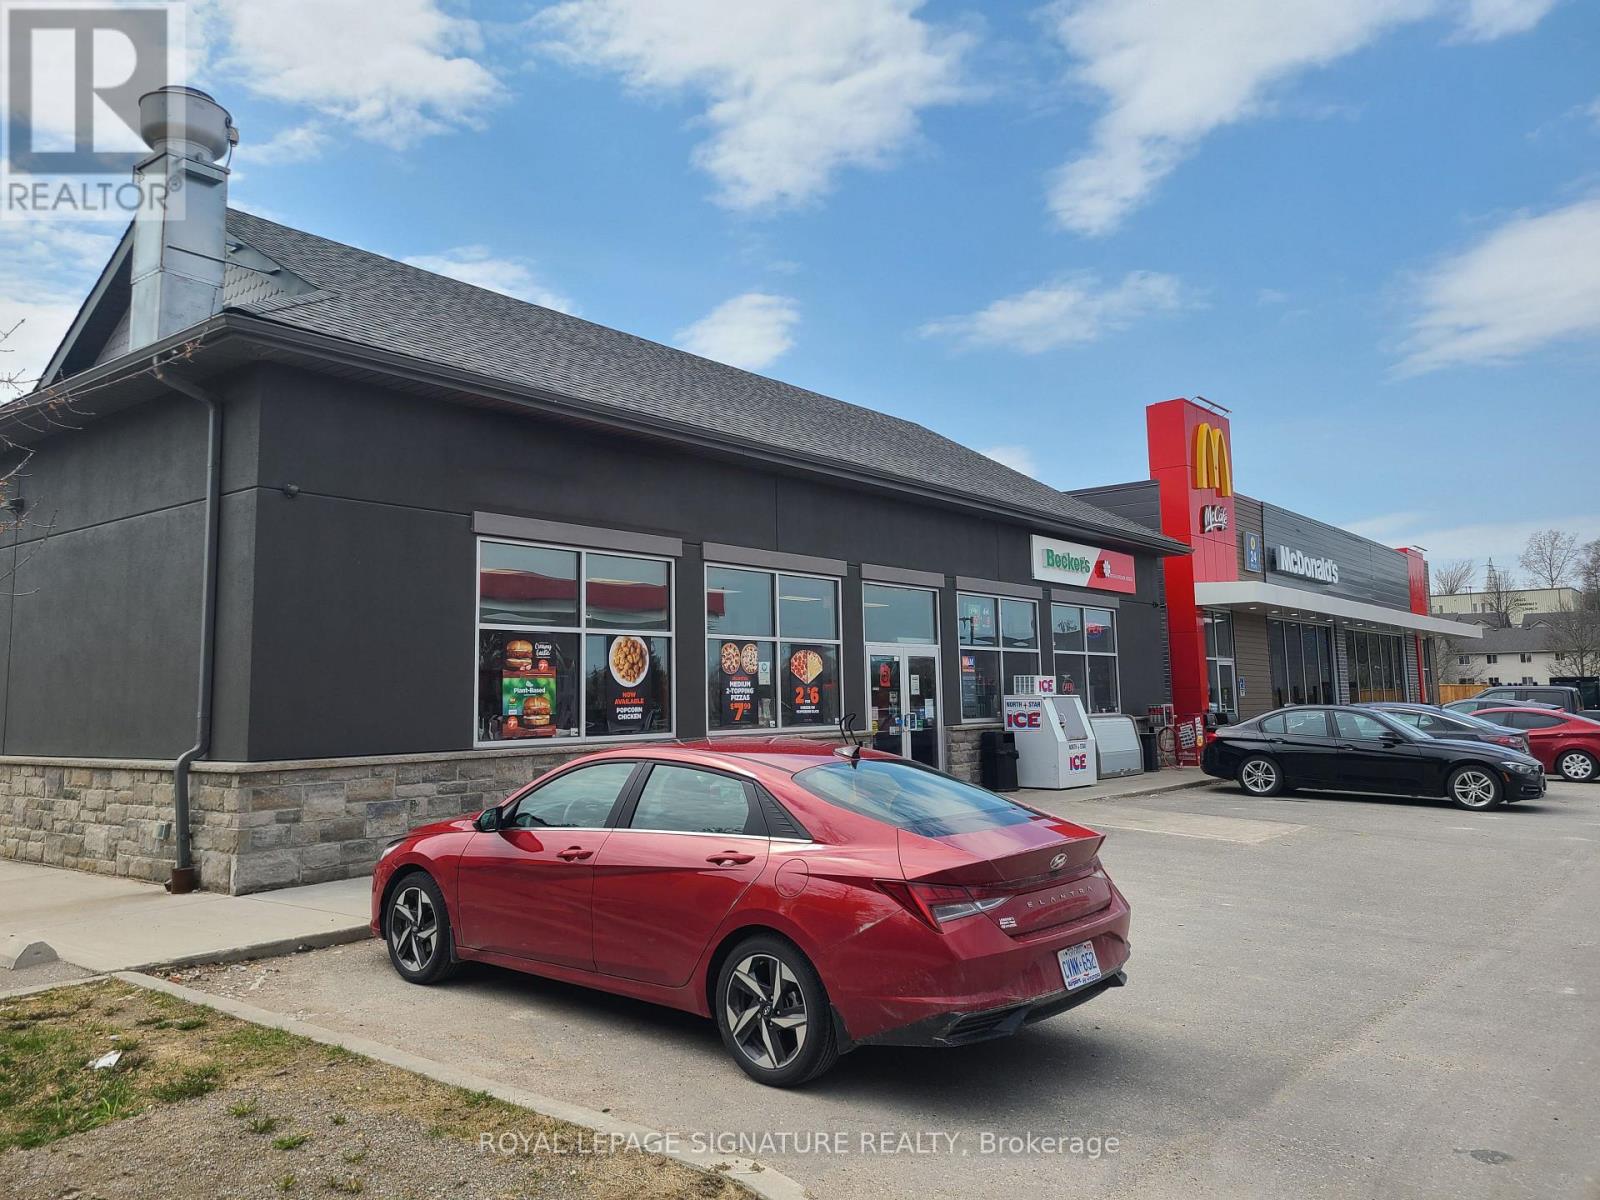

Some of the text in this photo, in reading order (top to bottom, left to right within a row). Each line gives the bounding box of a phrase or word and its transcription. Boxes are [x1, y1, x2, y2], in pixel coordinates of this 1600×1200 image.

[1046, 548, 1091, 574] Becker's
[1279, 544, 1339, 584] McDonald's
[1039, 679, 1054, 692] ICE
[795, 687, 804, 704] 2
[1007, 711, 1041, 729] ICE
[1069, 753, 1087, 771] ICE
[1027, 886, 1093, 908] ELANTRA
